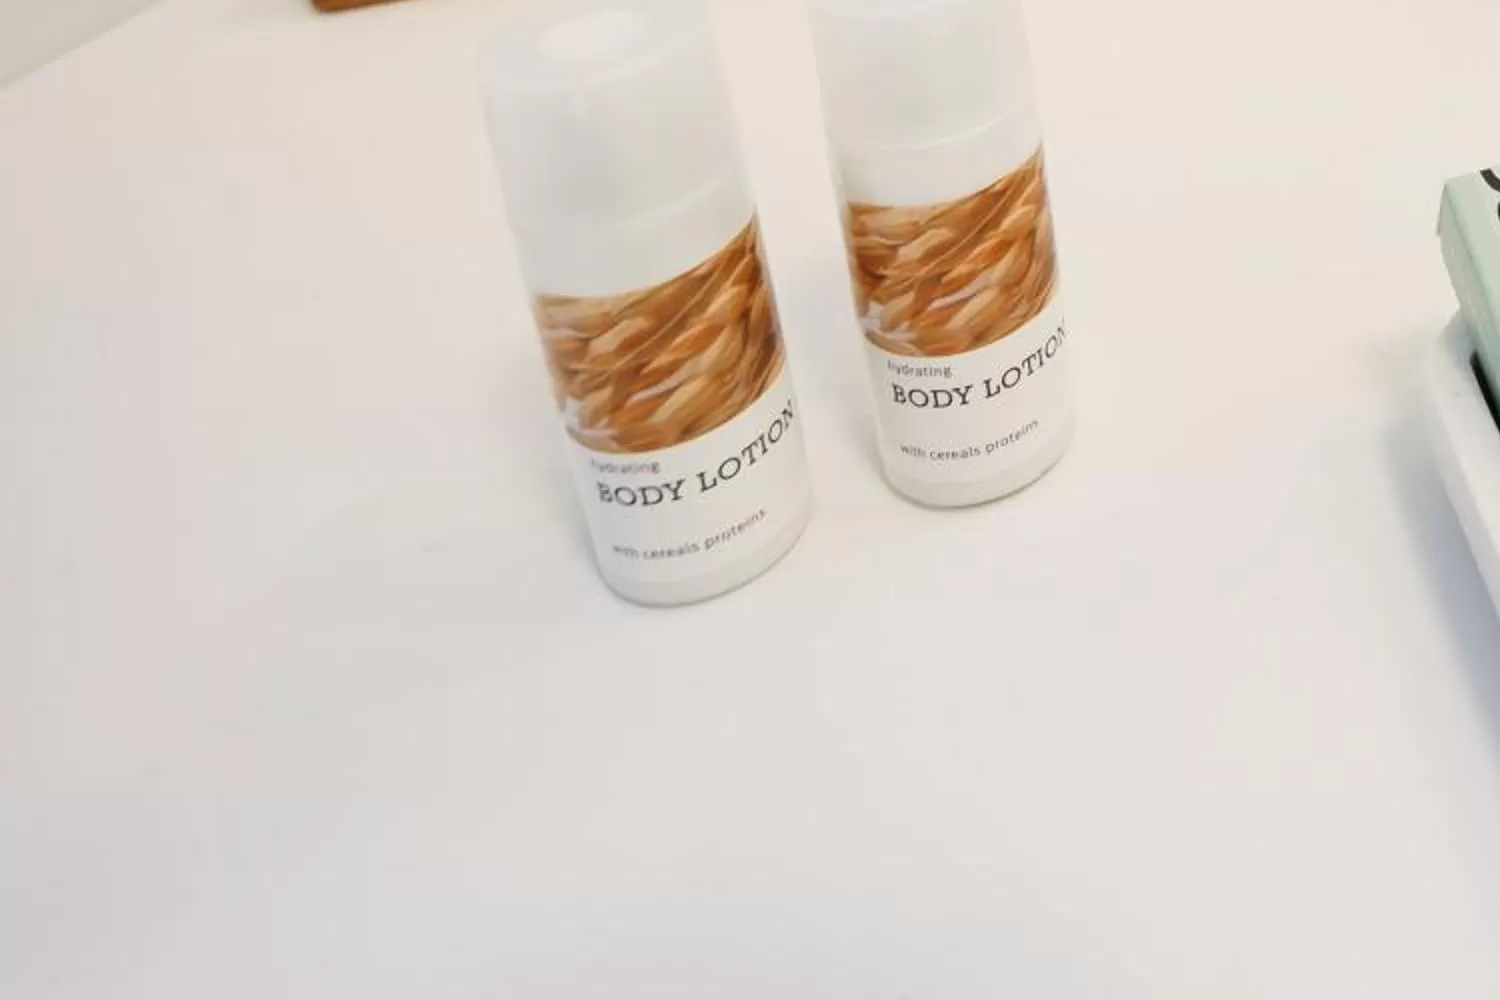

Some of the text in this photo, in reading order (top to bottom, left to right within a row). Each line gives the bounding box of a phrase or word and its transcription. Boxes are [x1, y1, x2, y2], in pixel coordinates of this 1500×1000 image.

[887, 360, 953, 378] hydrating
[891, 316, 1069, 409] BODY LOTION
[596, 399, 796, 506] BODY LOTION
[900, 419, 1039, 461] with cereals proteins
[643, 541, 700, 560] cereals
[704, 508, 766, 551] proteins
